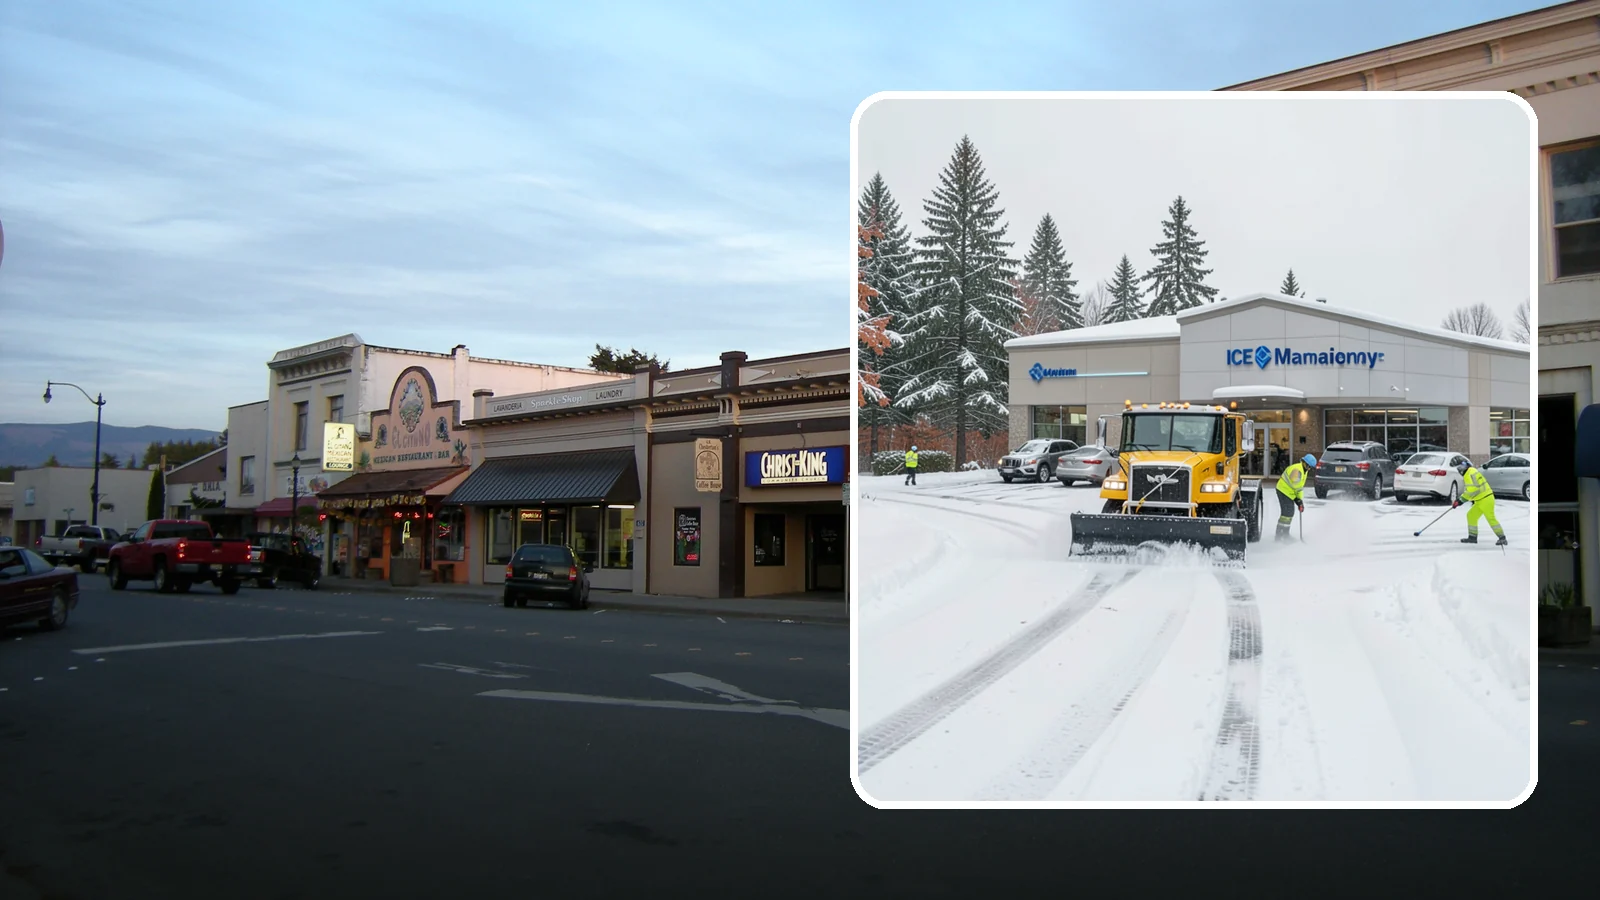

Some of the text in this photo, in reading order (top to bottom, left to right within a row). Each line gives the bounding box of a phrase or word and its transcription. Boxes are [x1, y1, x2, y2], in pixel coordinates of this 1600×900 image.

[1226, 348, 1254, 366] ICE
[562, 395, 583, 405] Shop
[595, 389, 623, 400] LAUNDRY
[493, 402, 523, 412] LAVANDERIA
[374, 455, 396, 464] MEXICAN
[397, 452, 433, 462] RESTAURANT
[438, 450, 450, 459] BAR
[761, 450, 827, 478] CHRIST KING
